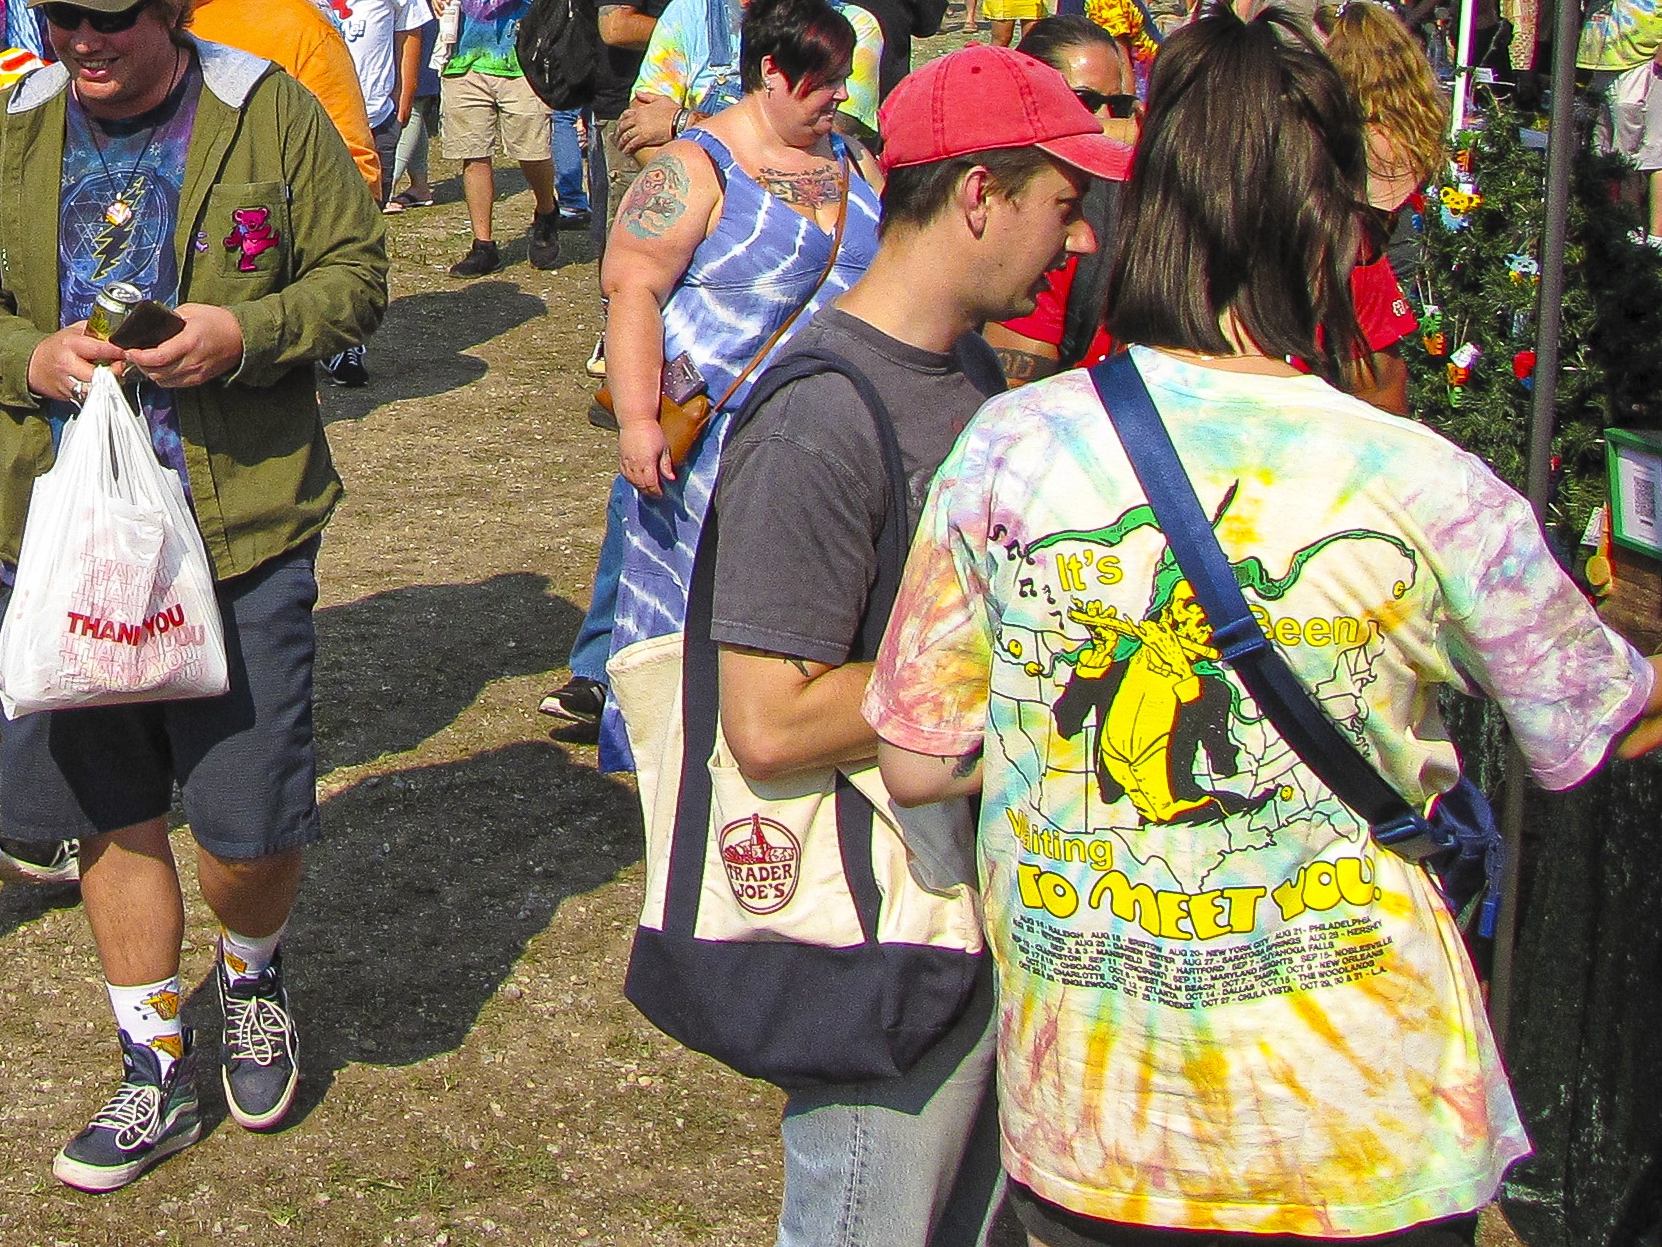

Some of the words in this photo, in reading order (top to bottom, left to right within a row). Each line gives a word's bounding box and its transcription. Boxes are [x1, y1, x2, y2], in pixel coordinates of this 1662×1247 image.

[1055, 548, 1124, 592] It's
[142, 604, 185, 638] YOU
[727, 863, 793, 882] TRADER
[735, 882, 786, 899] JOE'S
[1017, 861, 1079, 919] TO
[1089, 869, 1267, 941] MEET
[1286, 964, 1304, 974] OCT
[1185, 992, 1204, 1000] OCT
[1201, 998, 1218, 1007] OCT
[1300, 980, 1318, 990] OCT
